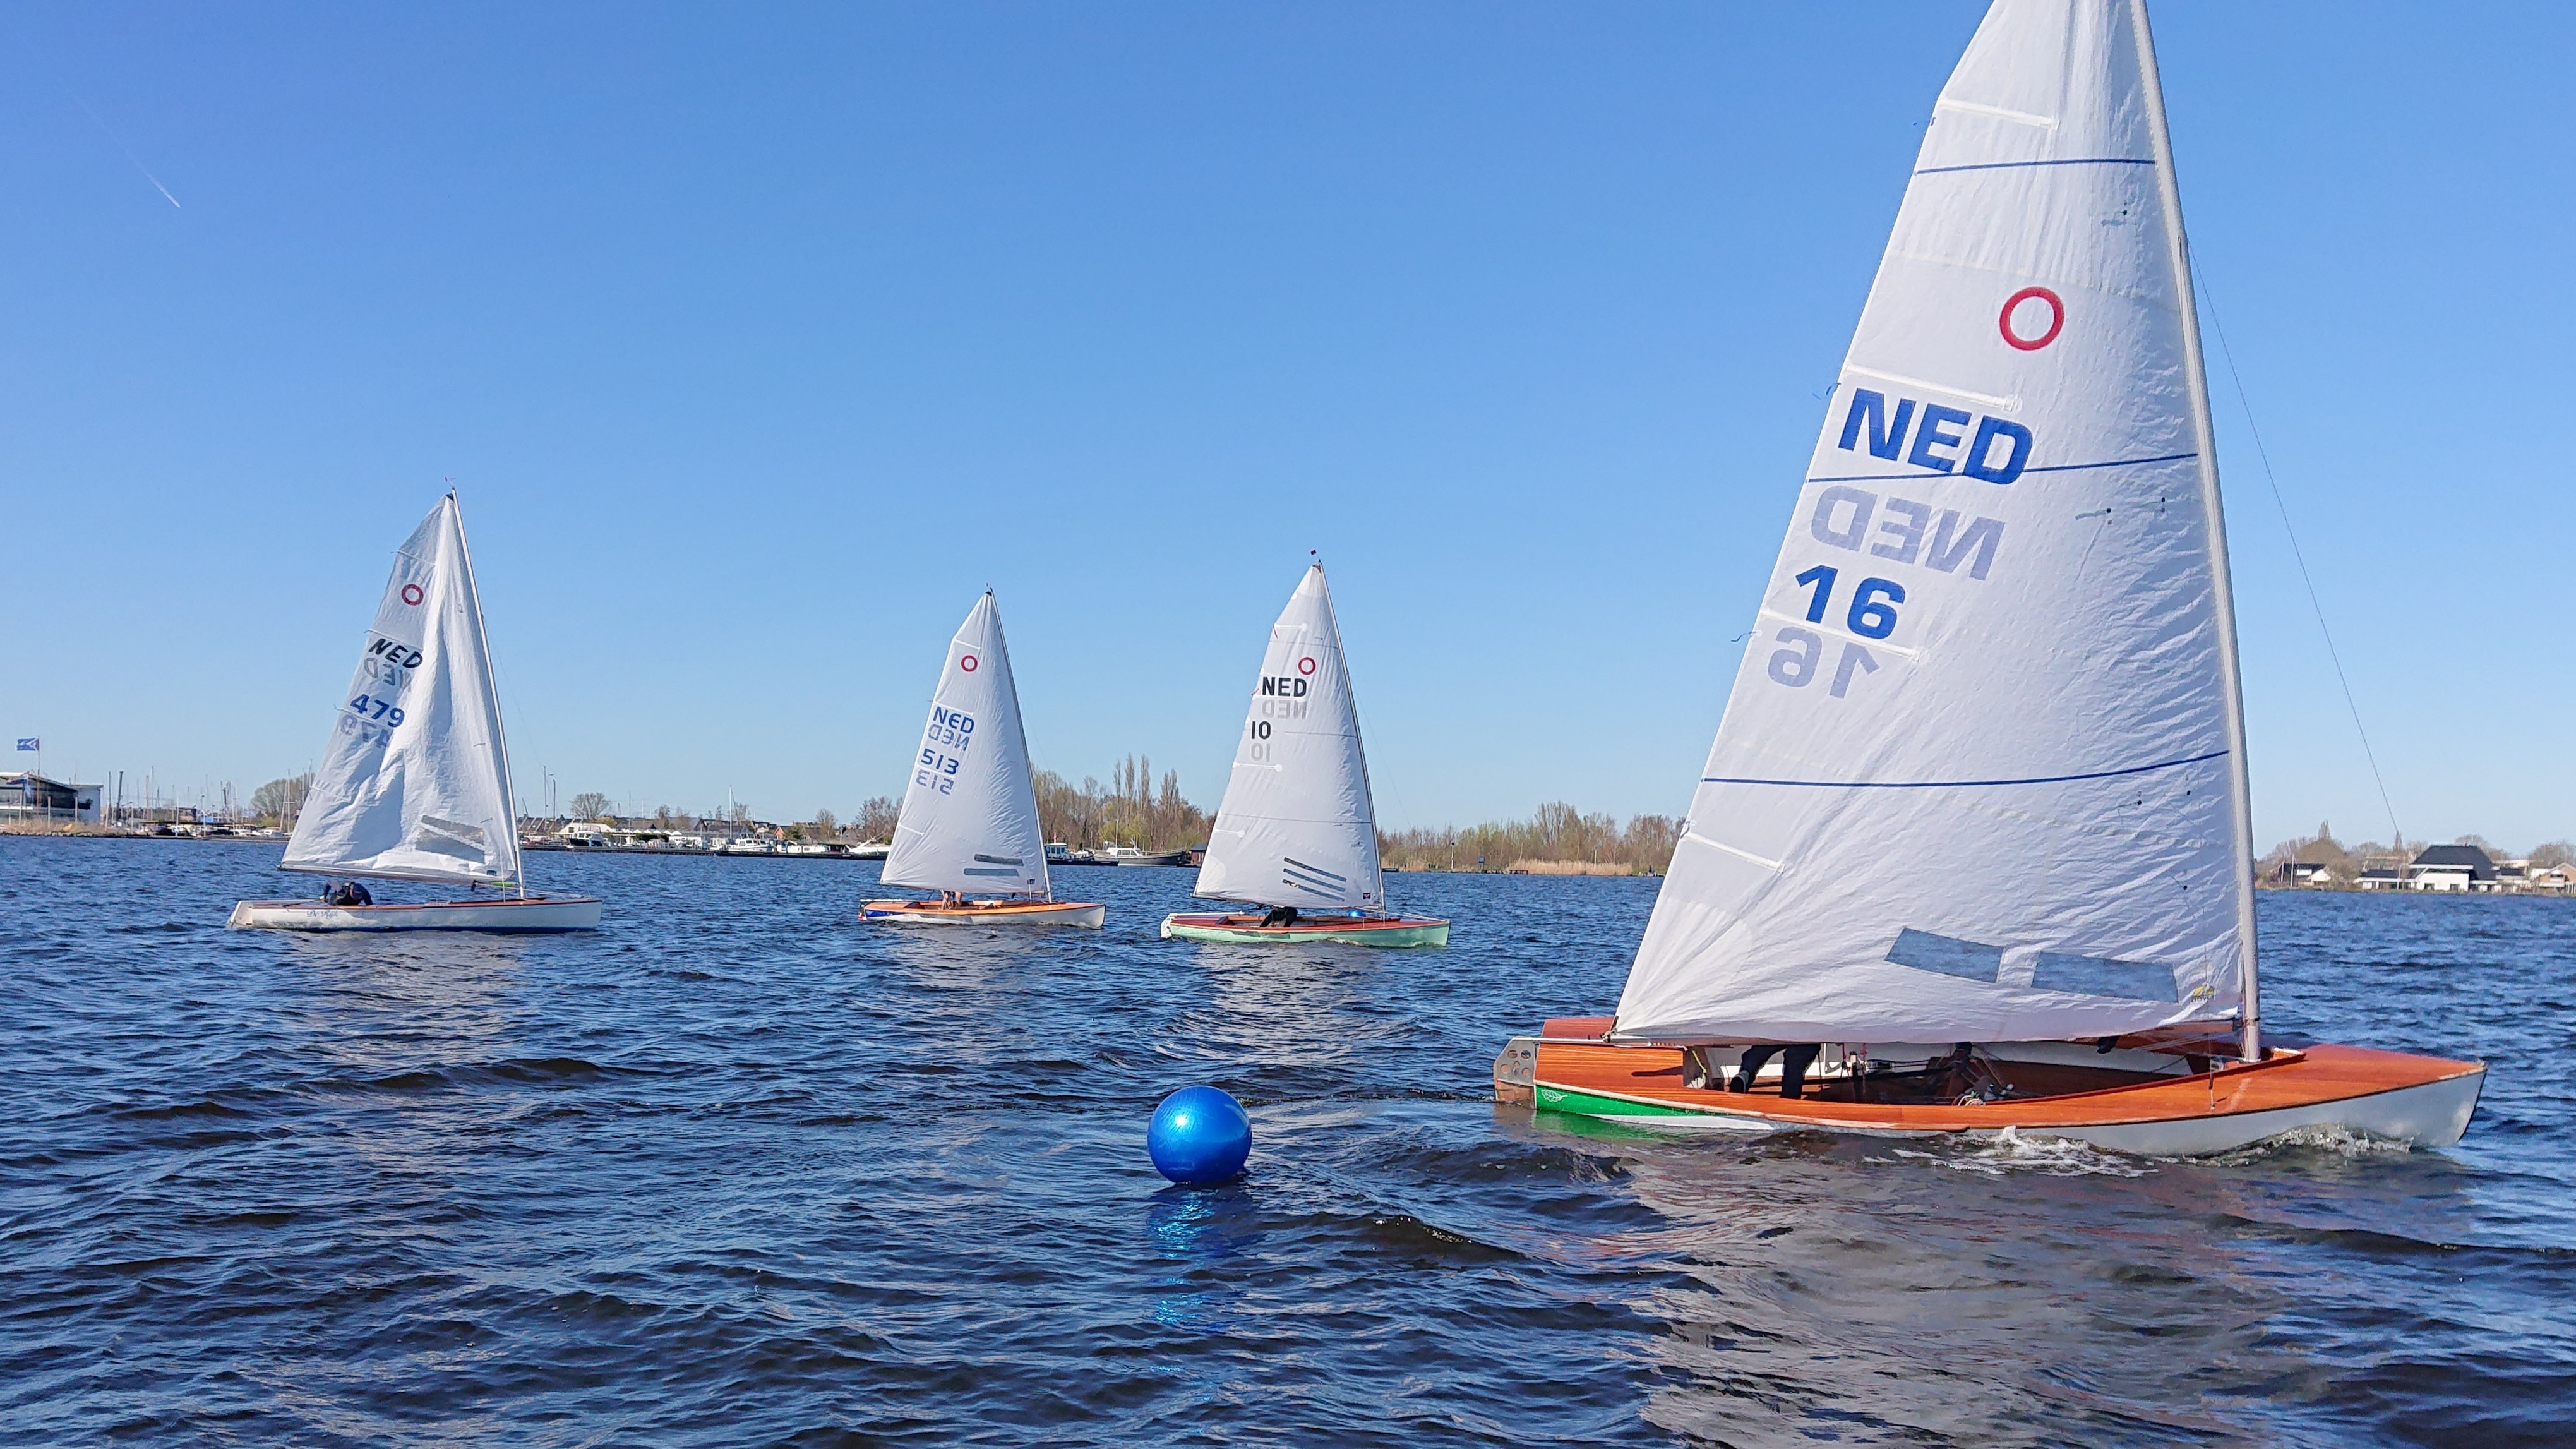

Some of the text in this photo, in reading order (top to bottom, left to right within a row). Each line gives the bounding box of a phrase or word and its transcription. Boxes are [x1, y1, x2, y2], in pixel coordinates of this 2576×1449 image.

[1838, 387, 2034, 485] NED
[1795, 564, 1906, 640] 16
[368, 638, 423, 668] NED
[1262, 676, 1307, 697] NED
[350, 694, 405, 728] 479
[933, 706, 975, 734] NED
[1251, 721, 1271, 740] 10
[921, 748, 959, 776] 513
